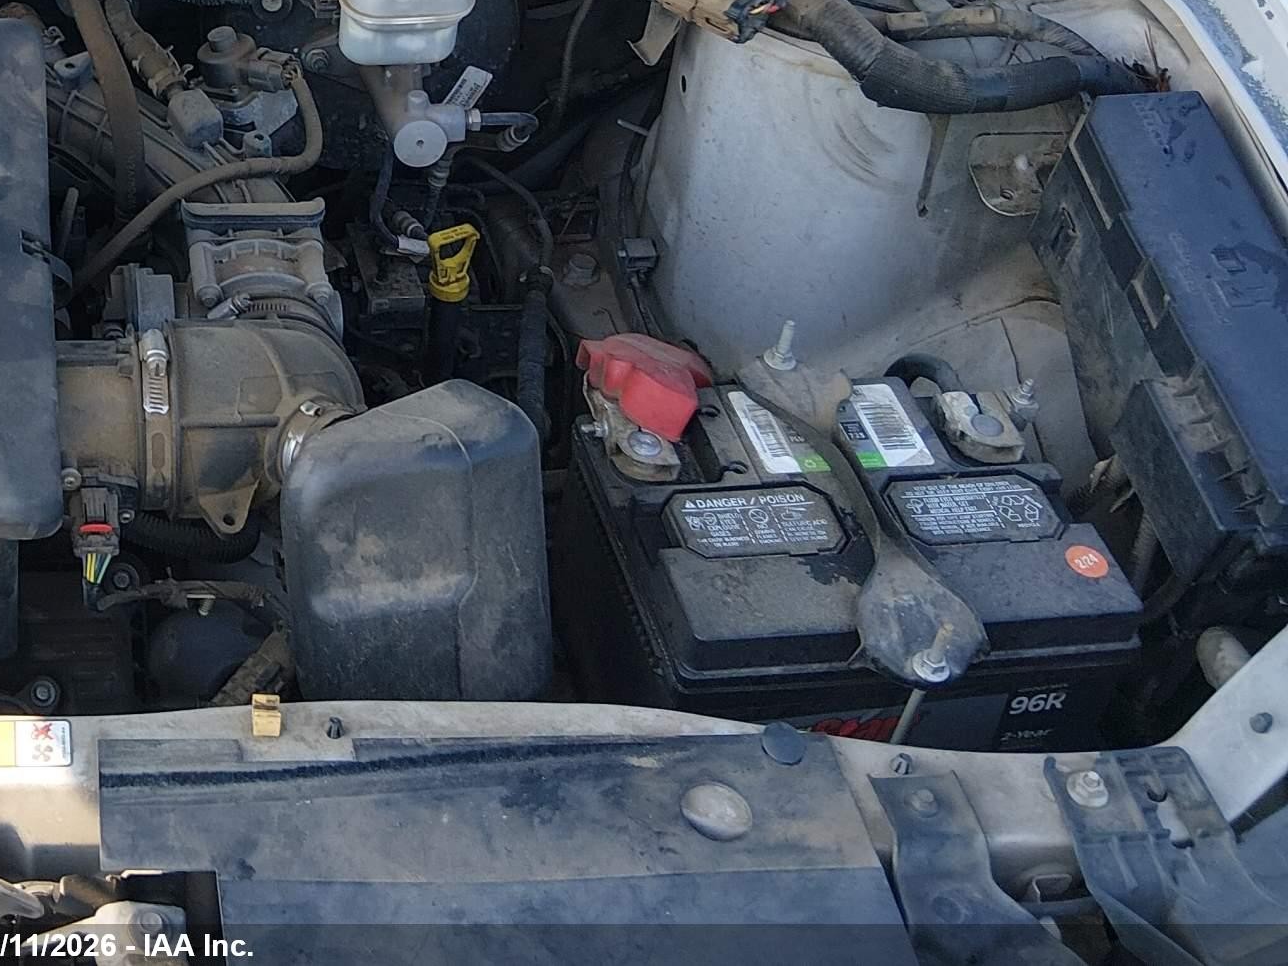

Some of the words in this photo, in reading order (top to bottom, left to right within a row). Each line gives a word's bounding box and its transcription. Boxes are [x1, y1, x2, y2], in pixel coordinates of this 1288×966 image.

[696, 497, 746, 508] DANGER
[759, 494, 805, 505] POISON
[1009, 693, 1066, 715] 96R
